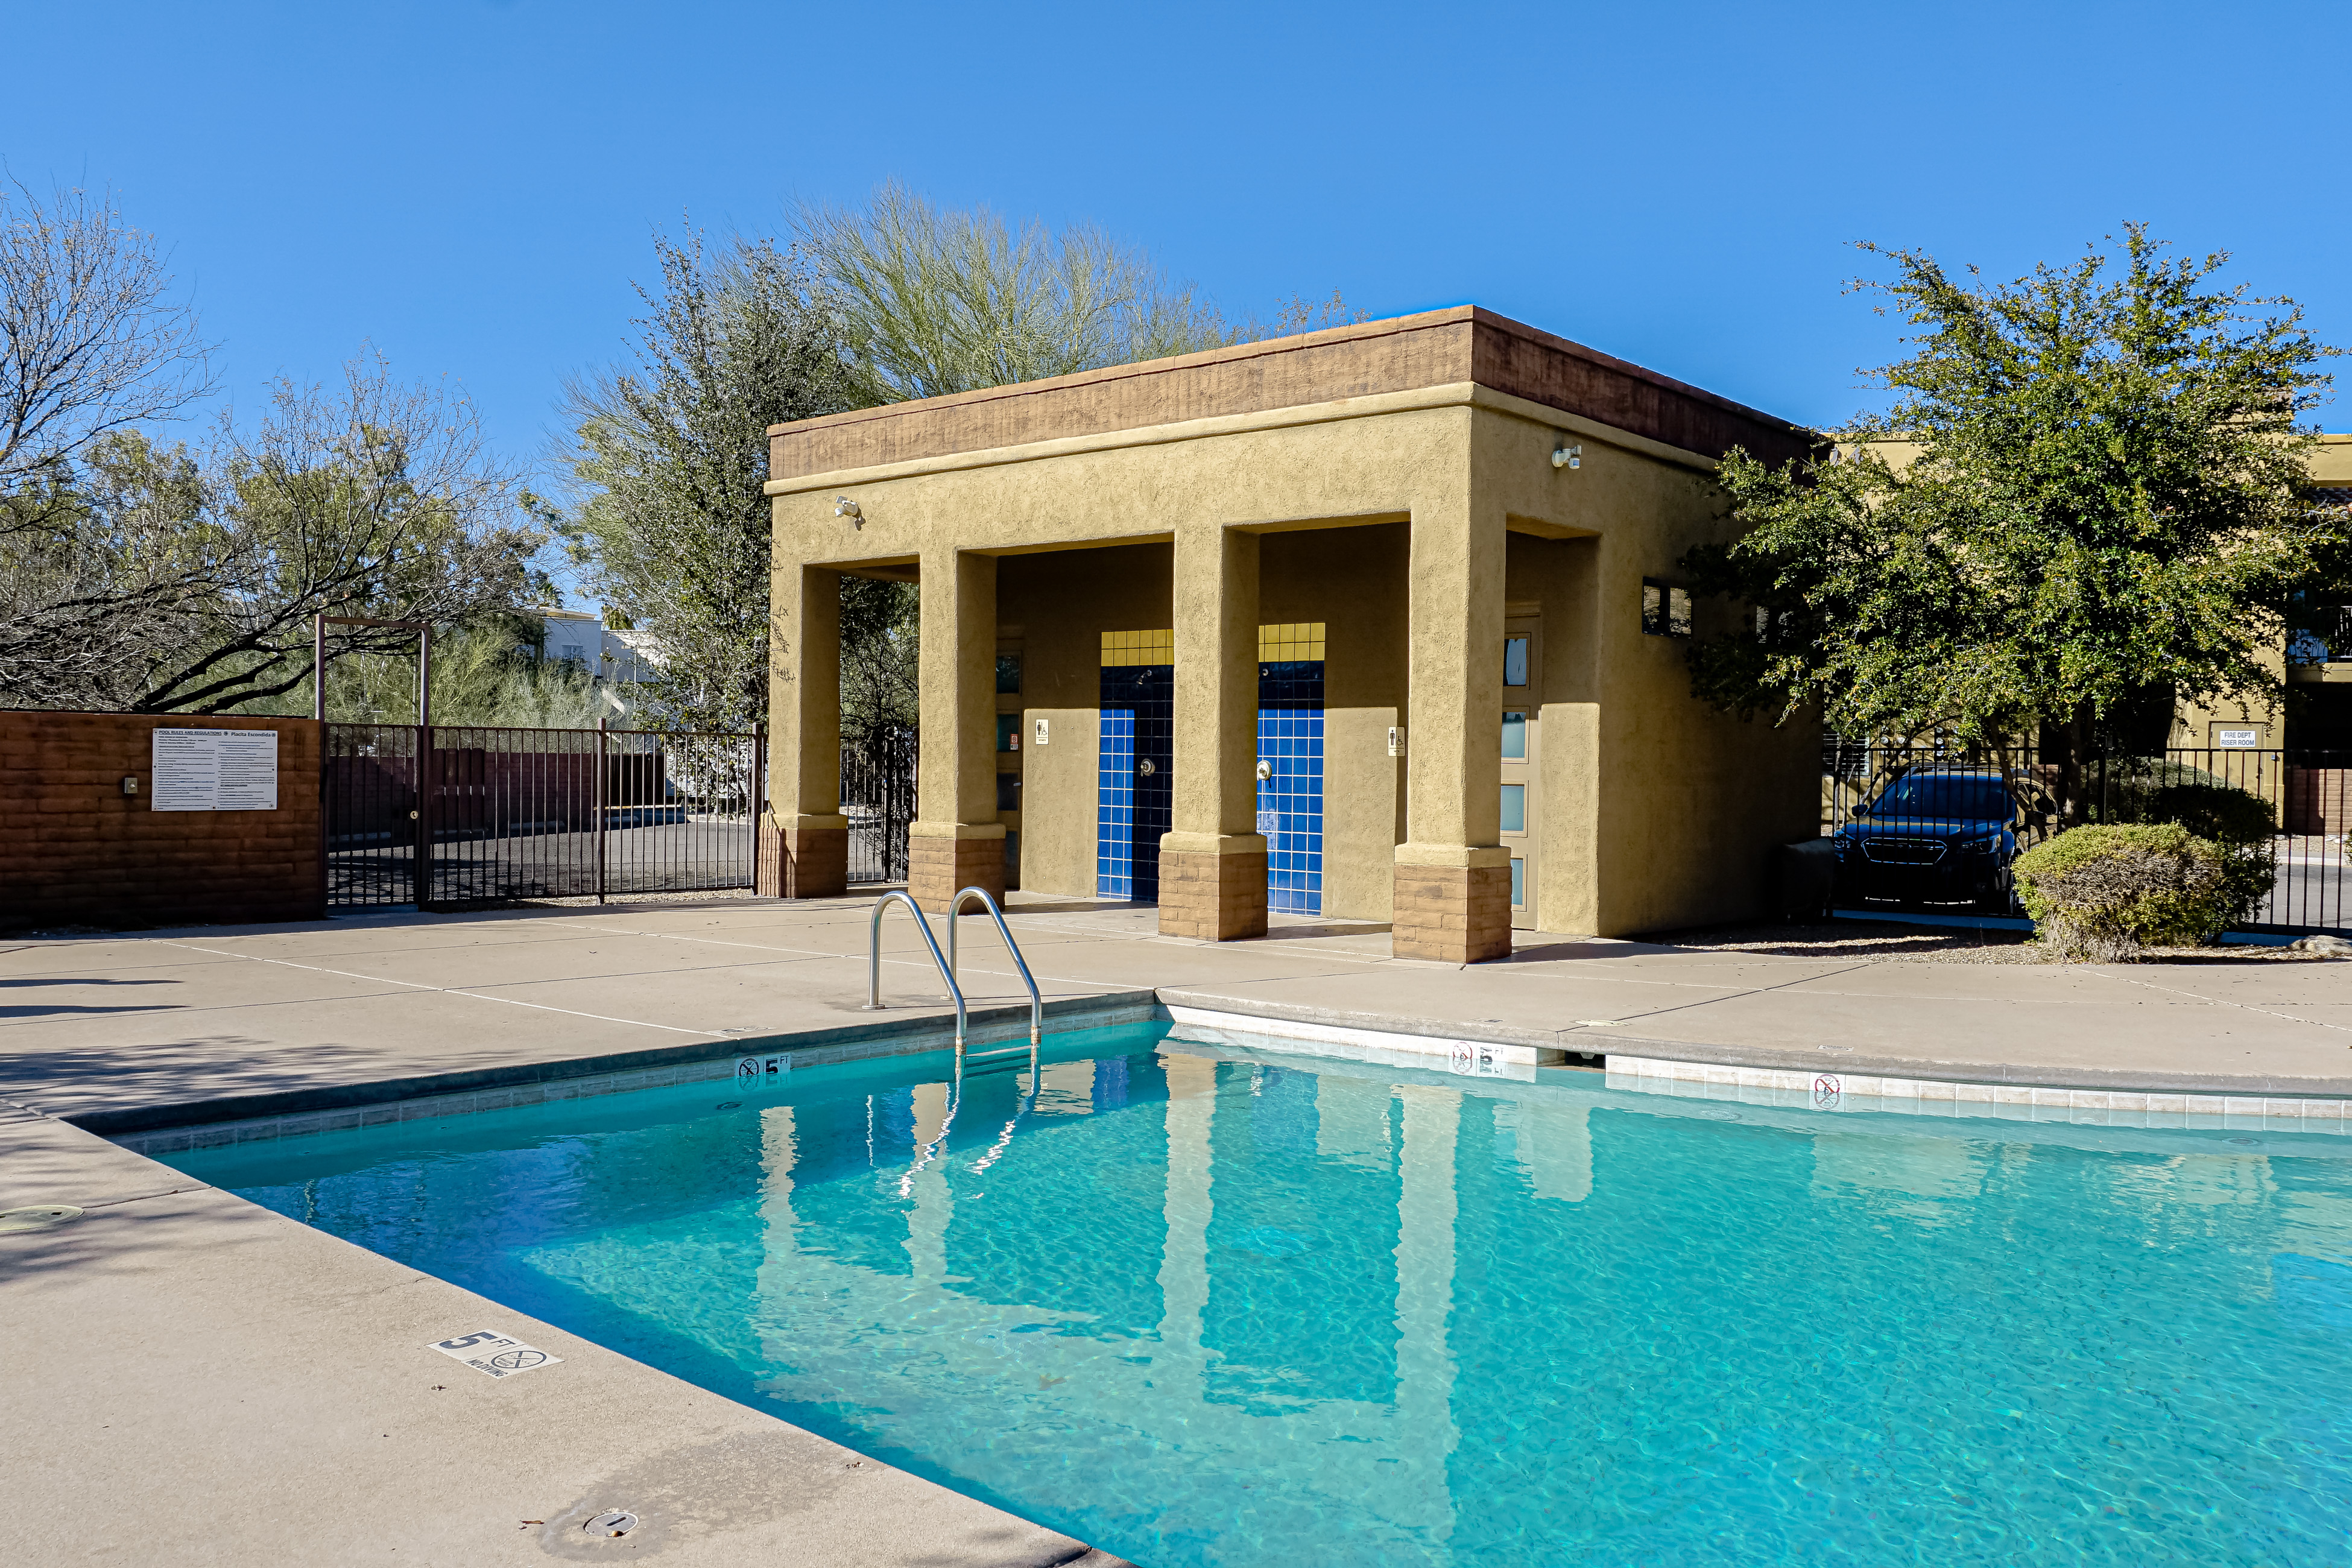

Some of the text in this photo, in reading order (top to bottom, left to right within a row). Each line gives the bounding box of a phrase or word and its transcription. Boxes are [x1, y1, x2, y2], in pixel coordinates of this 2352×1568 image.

[765, 1055, 789, 1075] 5 FT
[438, 1332, 516, 1350] 5 FT
[466, 1359, 508, 1377] NO DIVING
